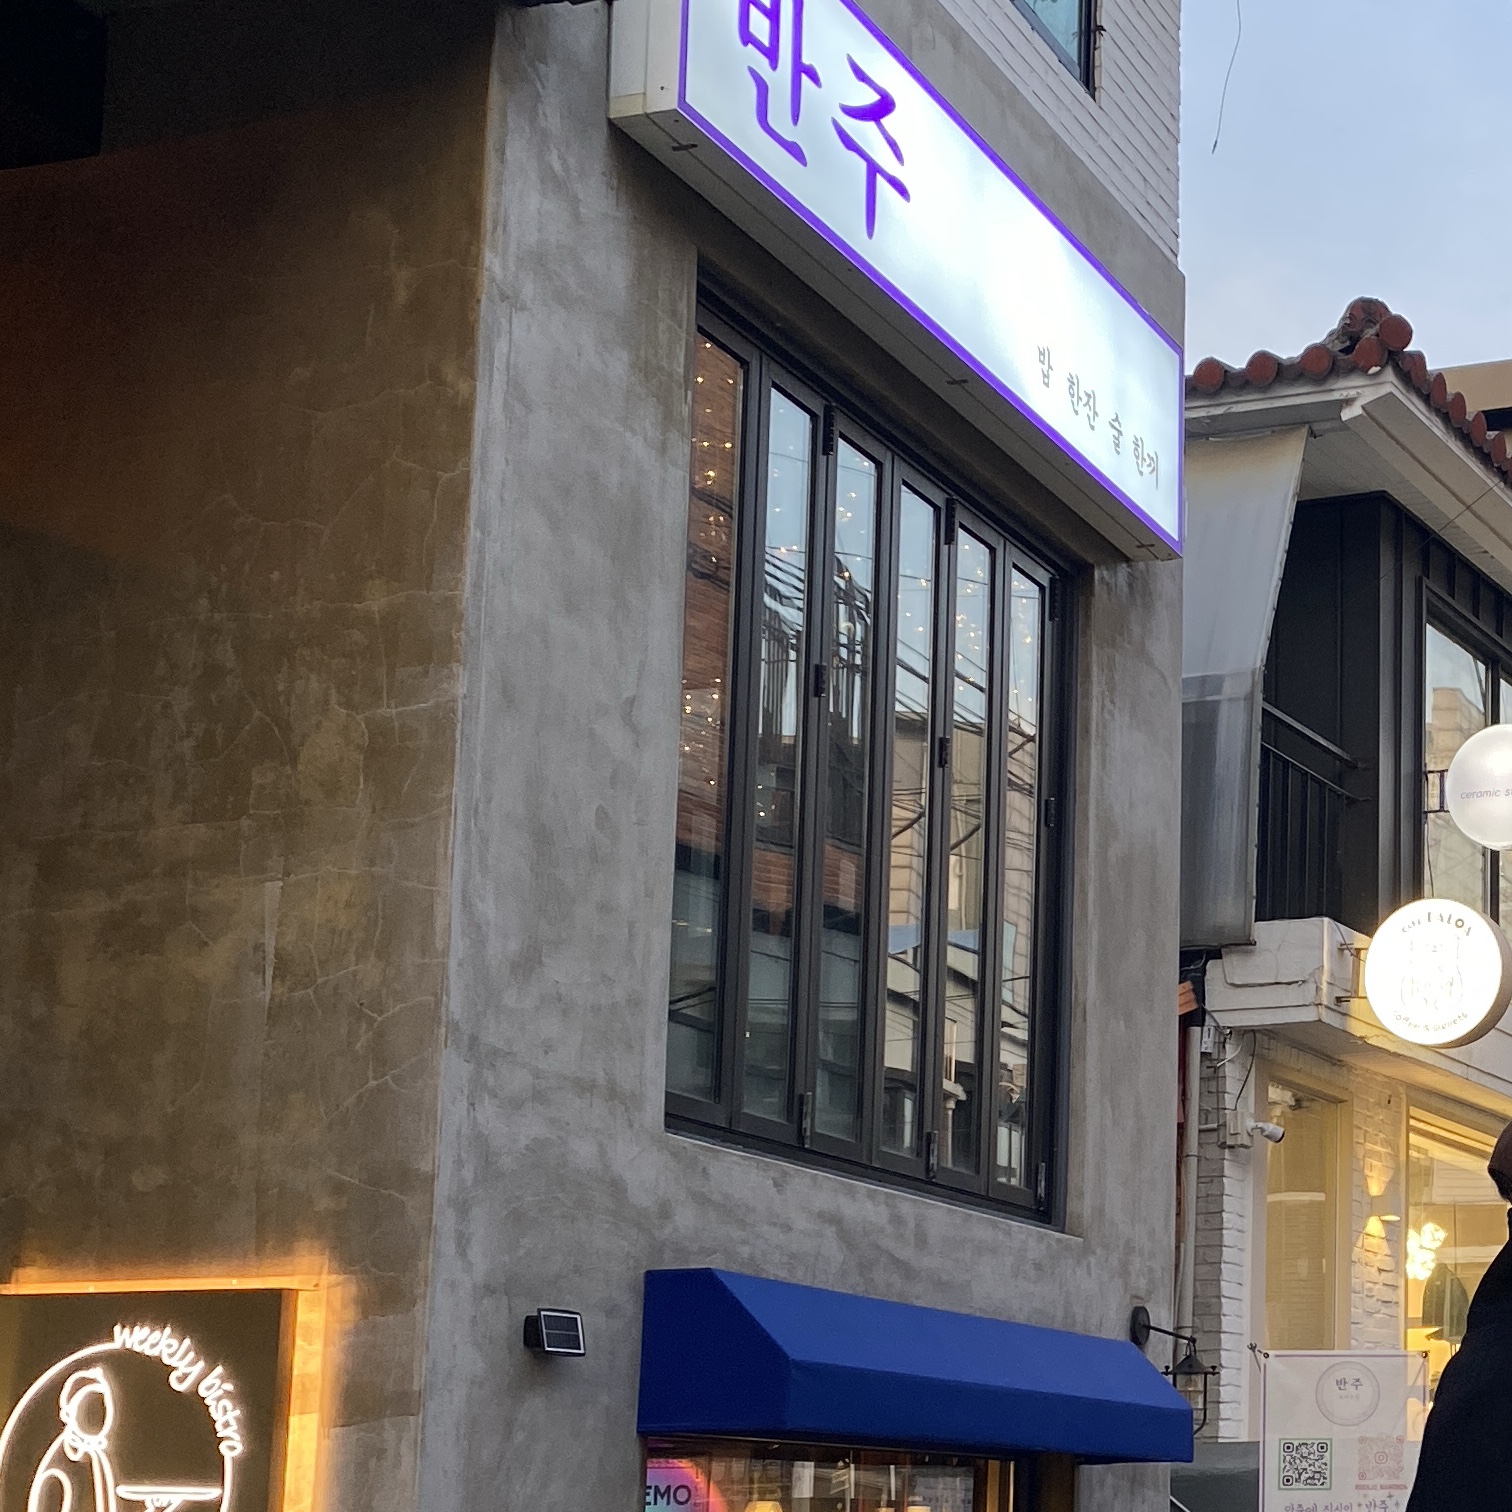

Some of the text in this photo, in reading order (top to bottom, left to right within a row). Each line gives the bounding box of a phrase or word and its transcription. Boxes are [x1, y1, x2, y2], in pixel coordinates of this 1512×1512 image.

[737, 0, 911, 240] 반주
[1037, 345, 1053, 388] 밥
[1067, 372, 1098, 431] 한잔
[1109, 412, 1124, 455] 술
[1460, 788, 1501, 800] ceramic
[113, 1322, 243, 1457] weekly bistro
[1336, 1377, 1363, 1391] 반주
